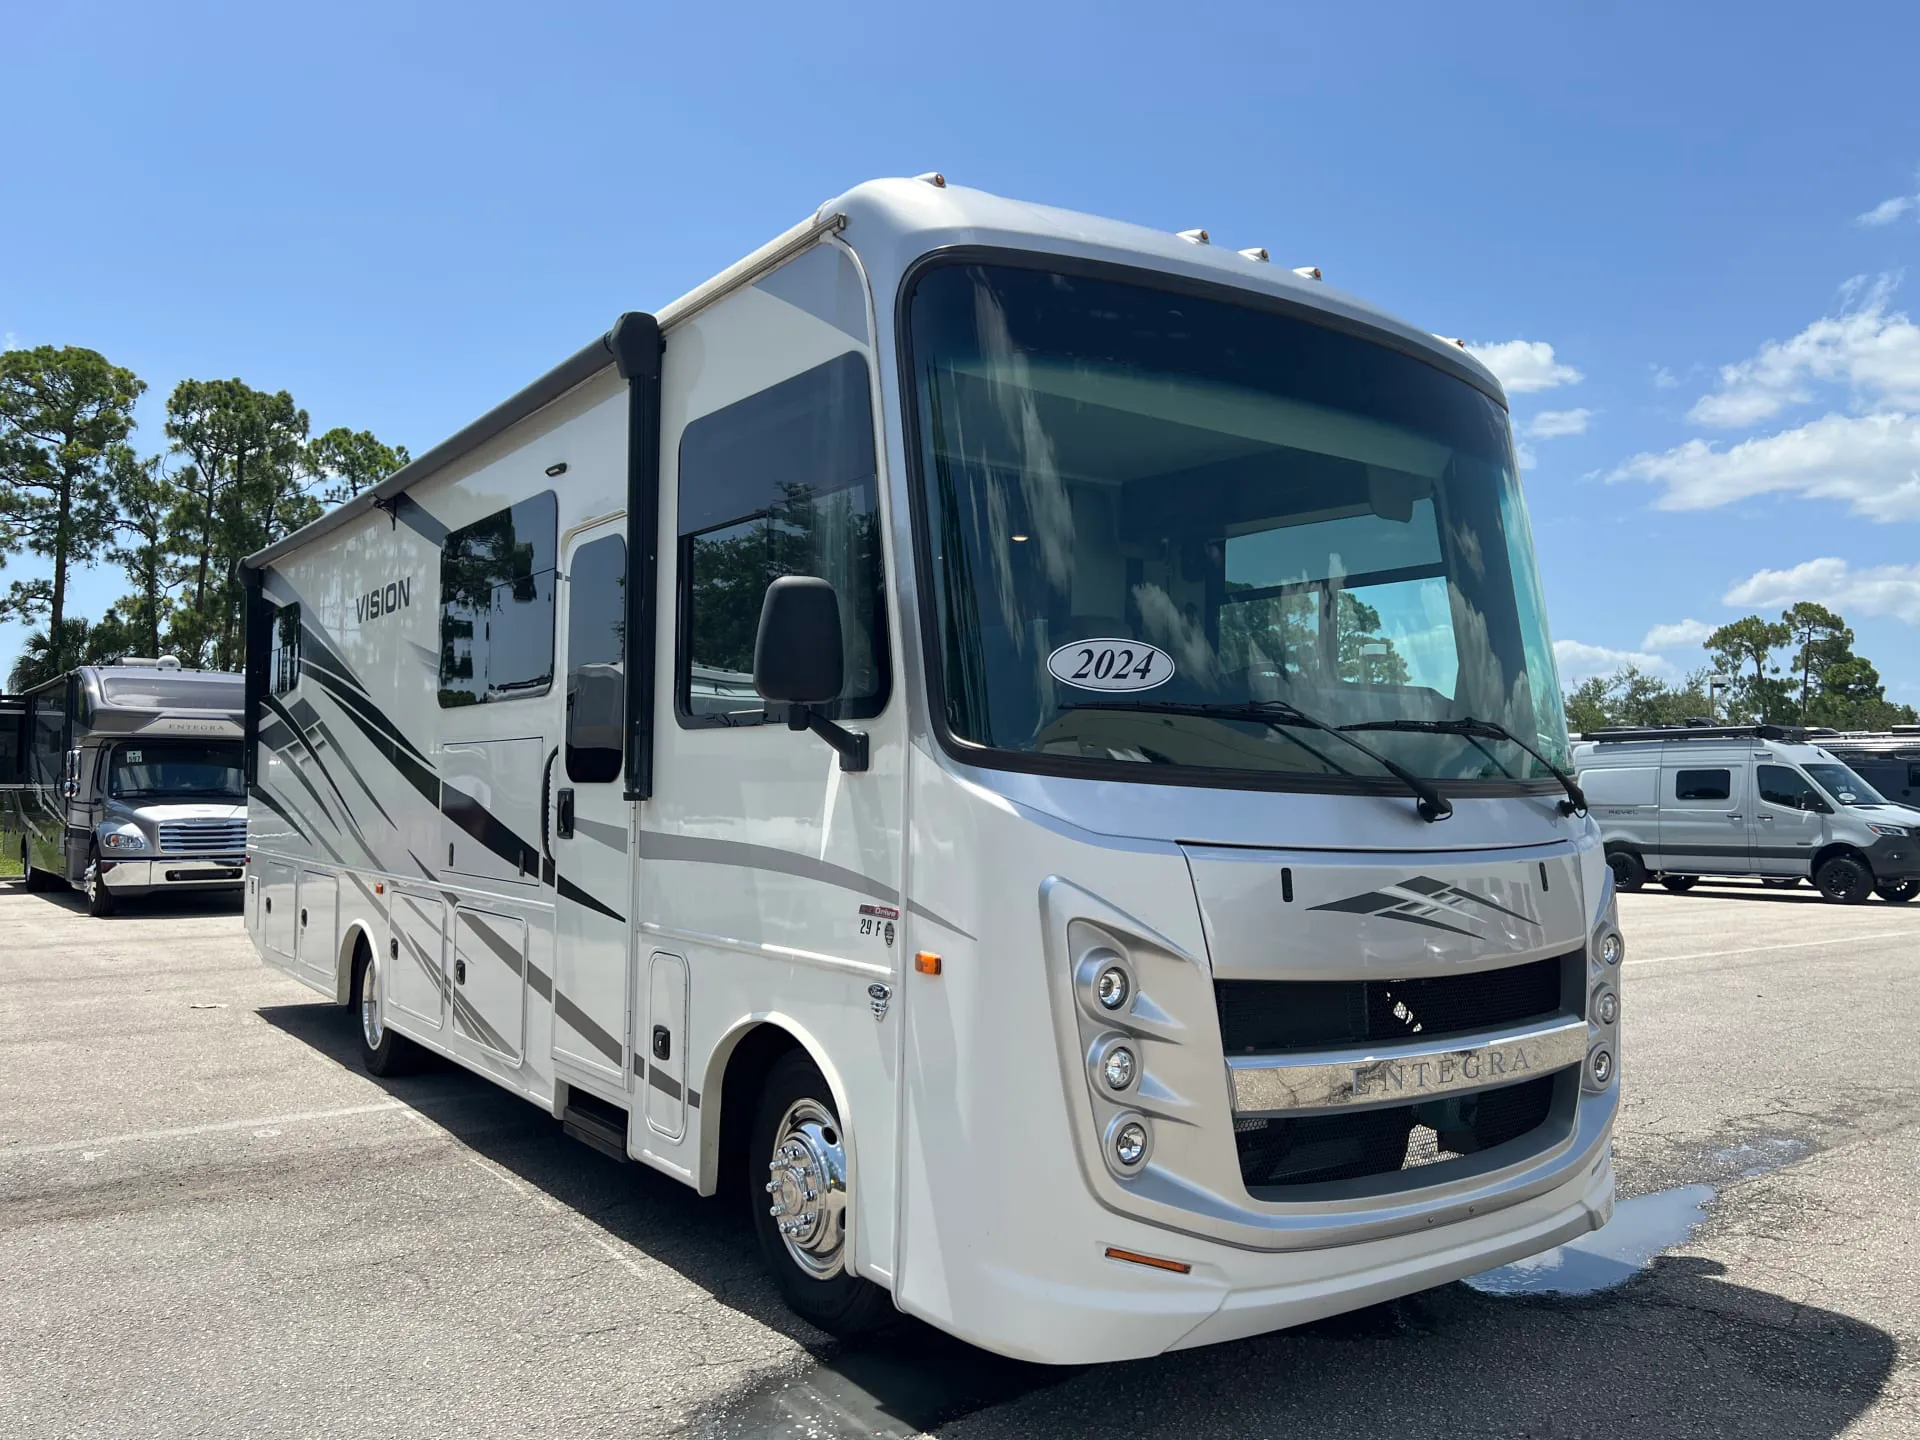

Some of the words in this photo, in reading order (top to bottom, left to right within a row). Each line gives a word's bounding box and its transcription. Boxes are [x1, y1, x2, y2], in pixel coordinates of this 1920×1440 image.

[356, 576, 411, 624] VISION
[1071, 648, 1155, 680] 2024
[860, 918, 872, 935] 29
[875, 920, 881, 937] F
[1350, 1047, 1530, 1097] ENTEGRA
